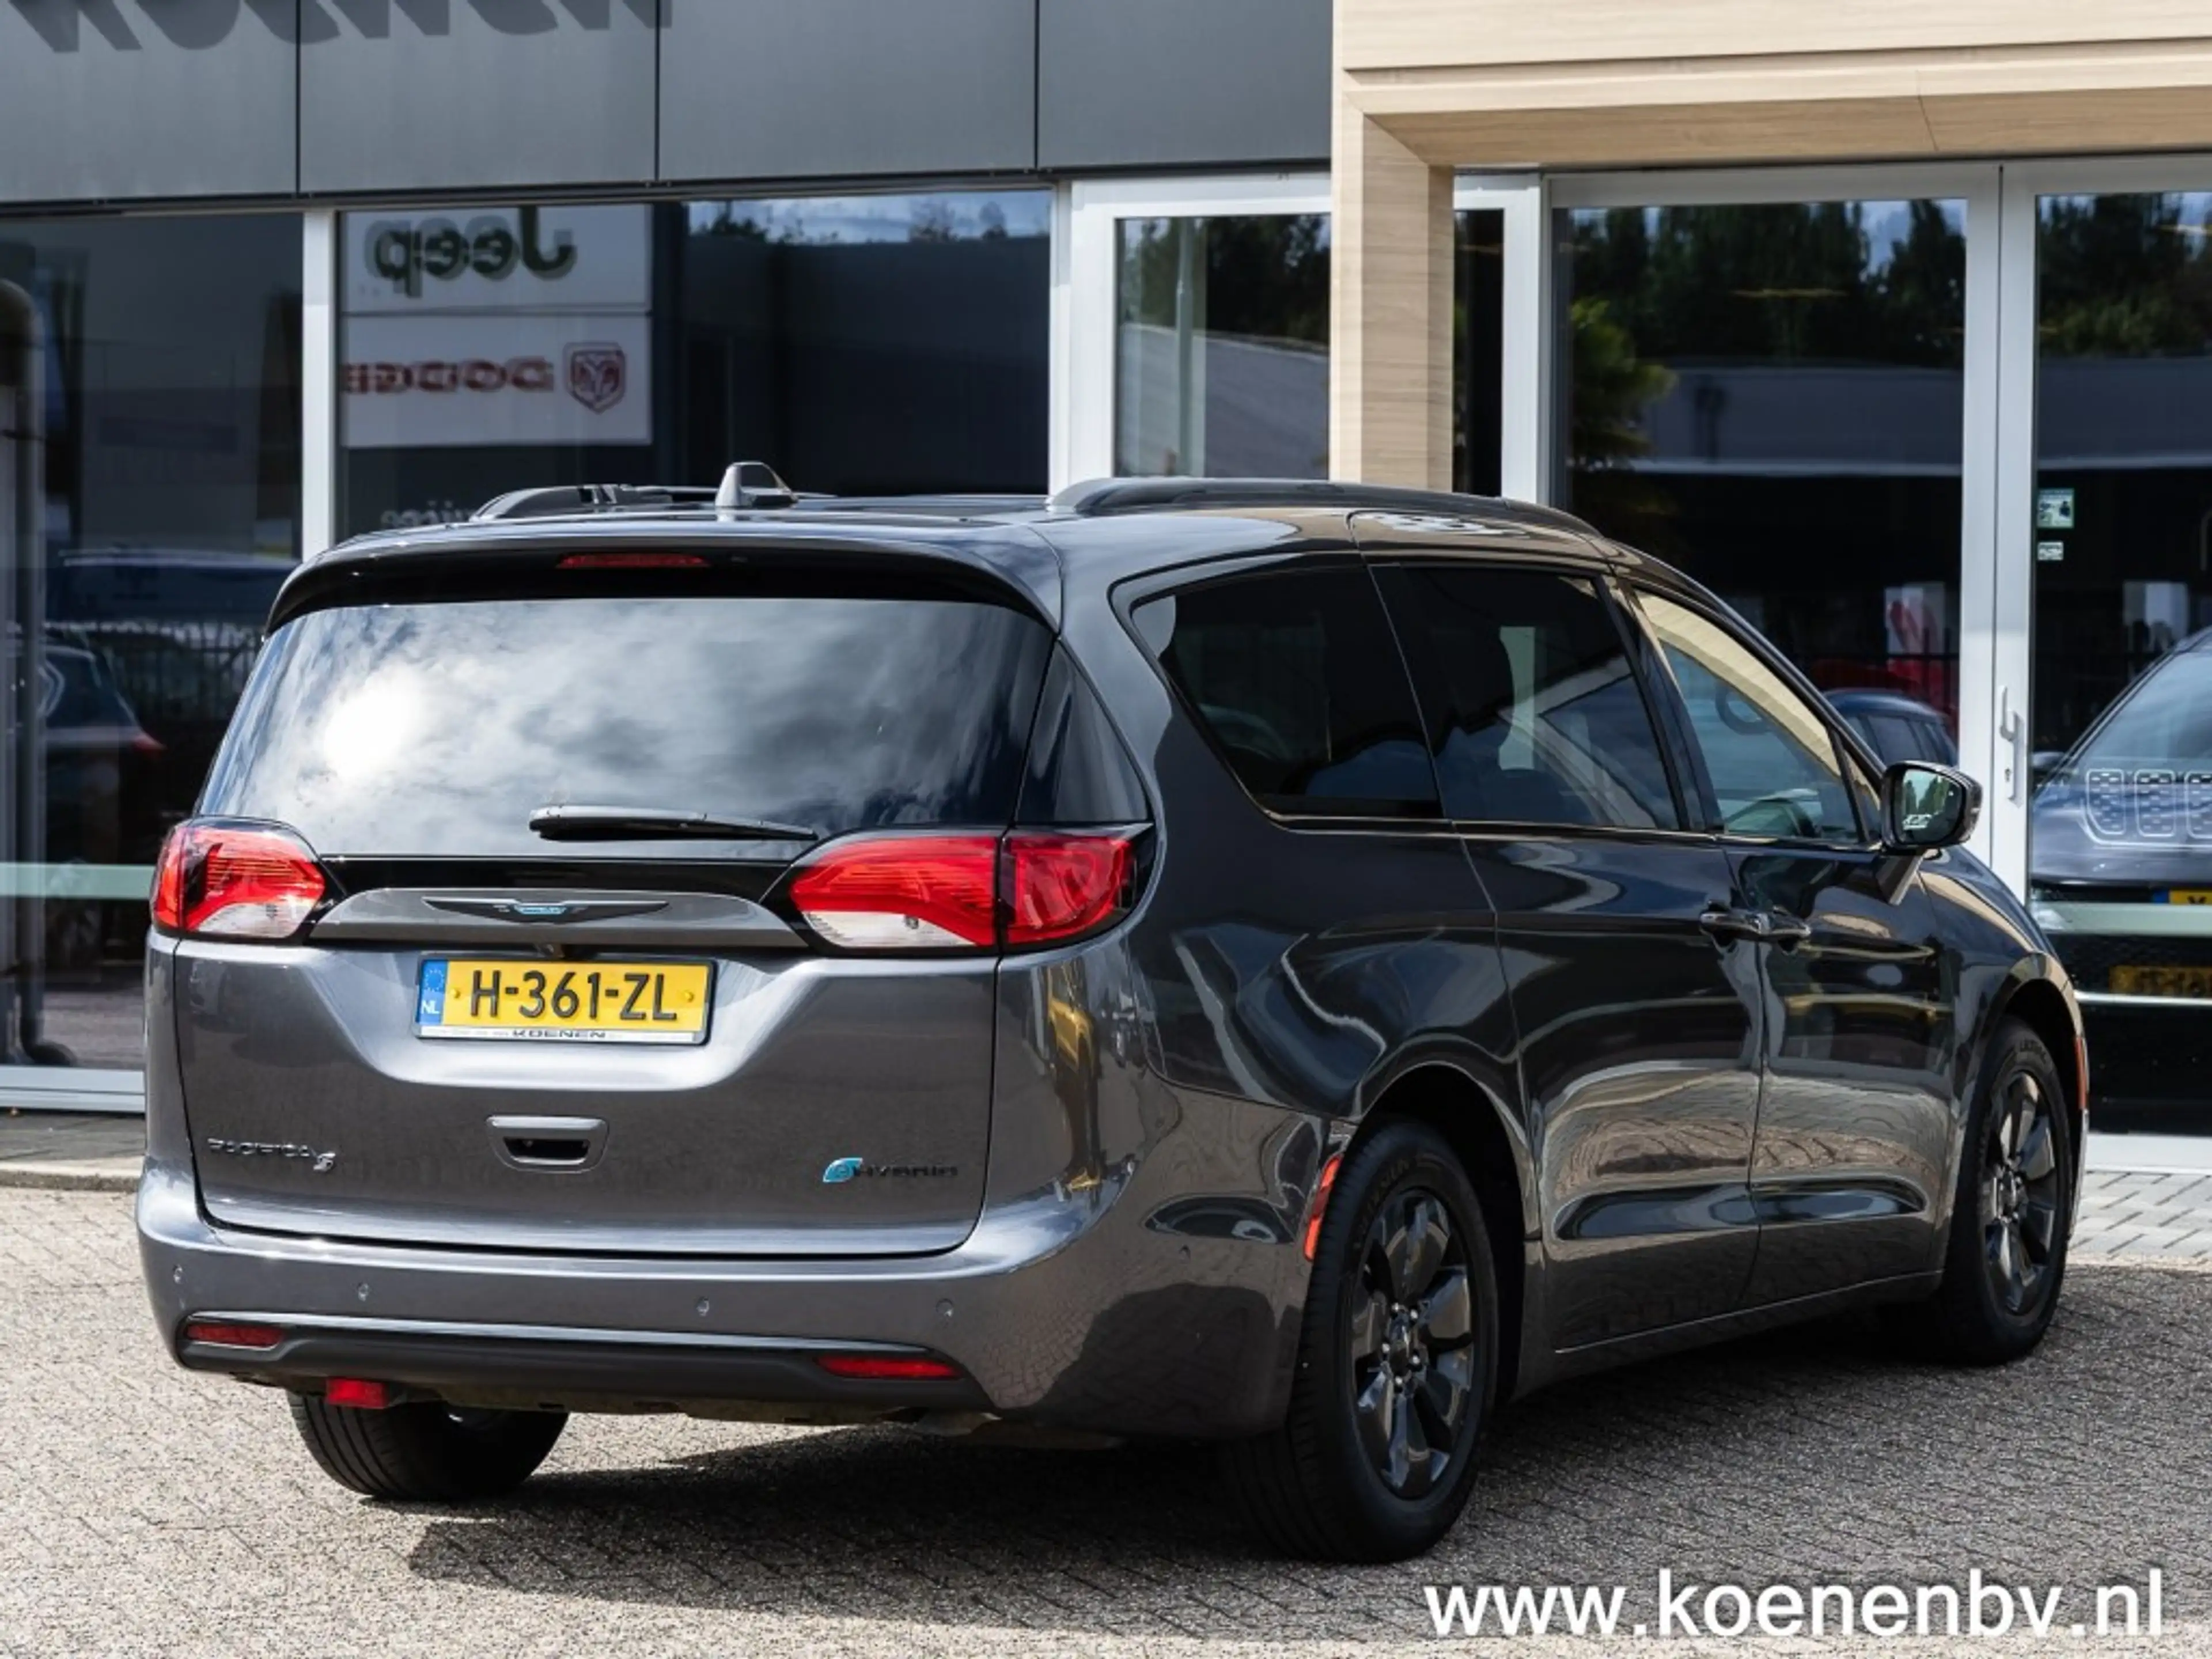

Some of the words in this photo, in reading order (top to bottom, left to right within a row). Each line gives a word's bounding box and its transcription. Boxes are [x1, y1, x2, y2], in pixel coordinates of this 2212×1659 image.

[470, 969, 677, 1021] H-361-ZL
[421, 999, 440, 1014] NL
[512, 1028, 606, 1039] KOENEN
